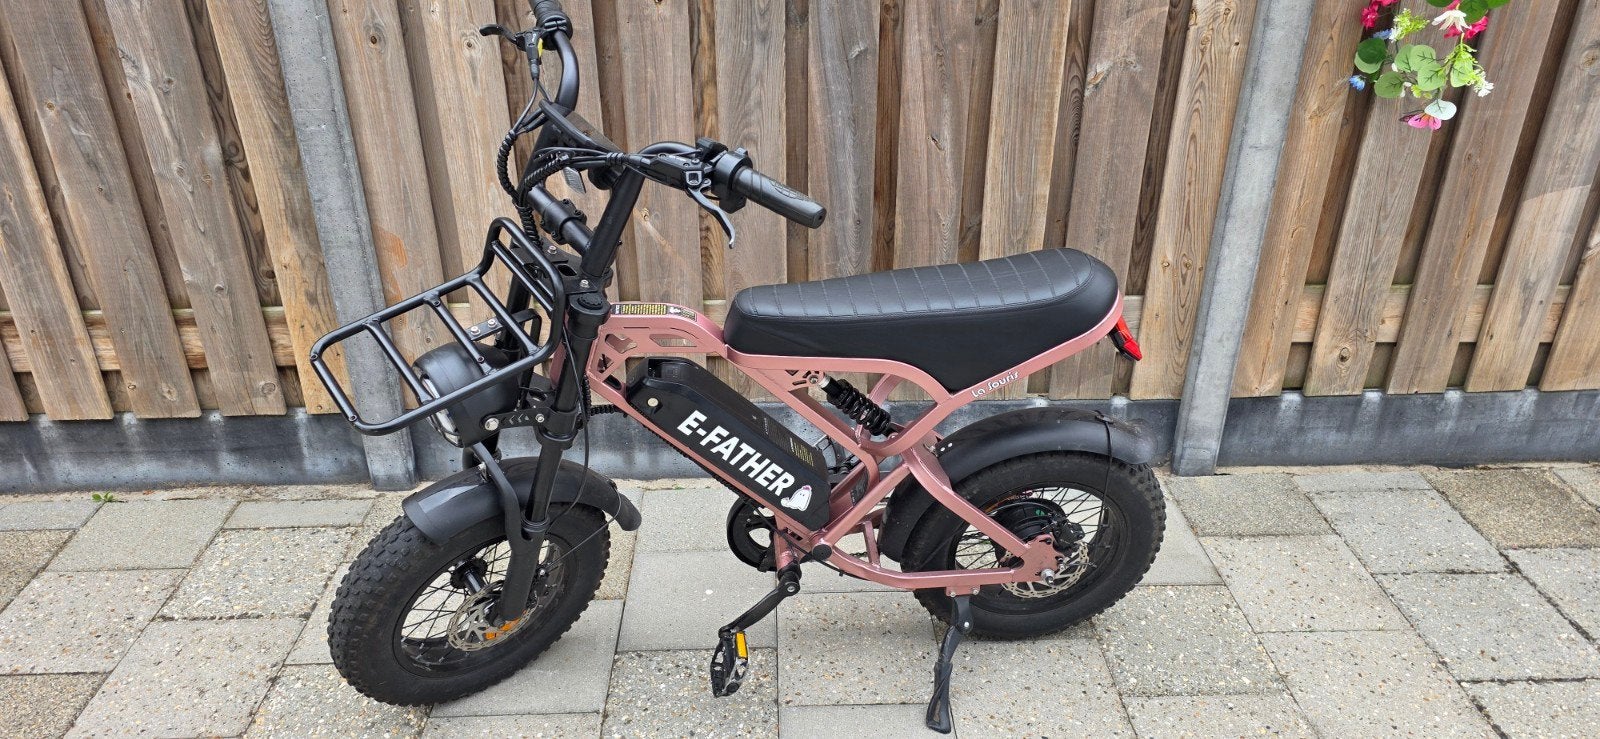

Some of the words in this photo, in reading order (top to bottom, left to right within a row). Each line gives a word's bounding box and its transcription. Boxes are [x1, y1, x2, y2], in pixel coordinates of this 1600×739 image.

[971, 388, 986, 398] La
[988, 371, 1019, 391] Souris
[677, 410, 795, 496] E-FATHER
